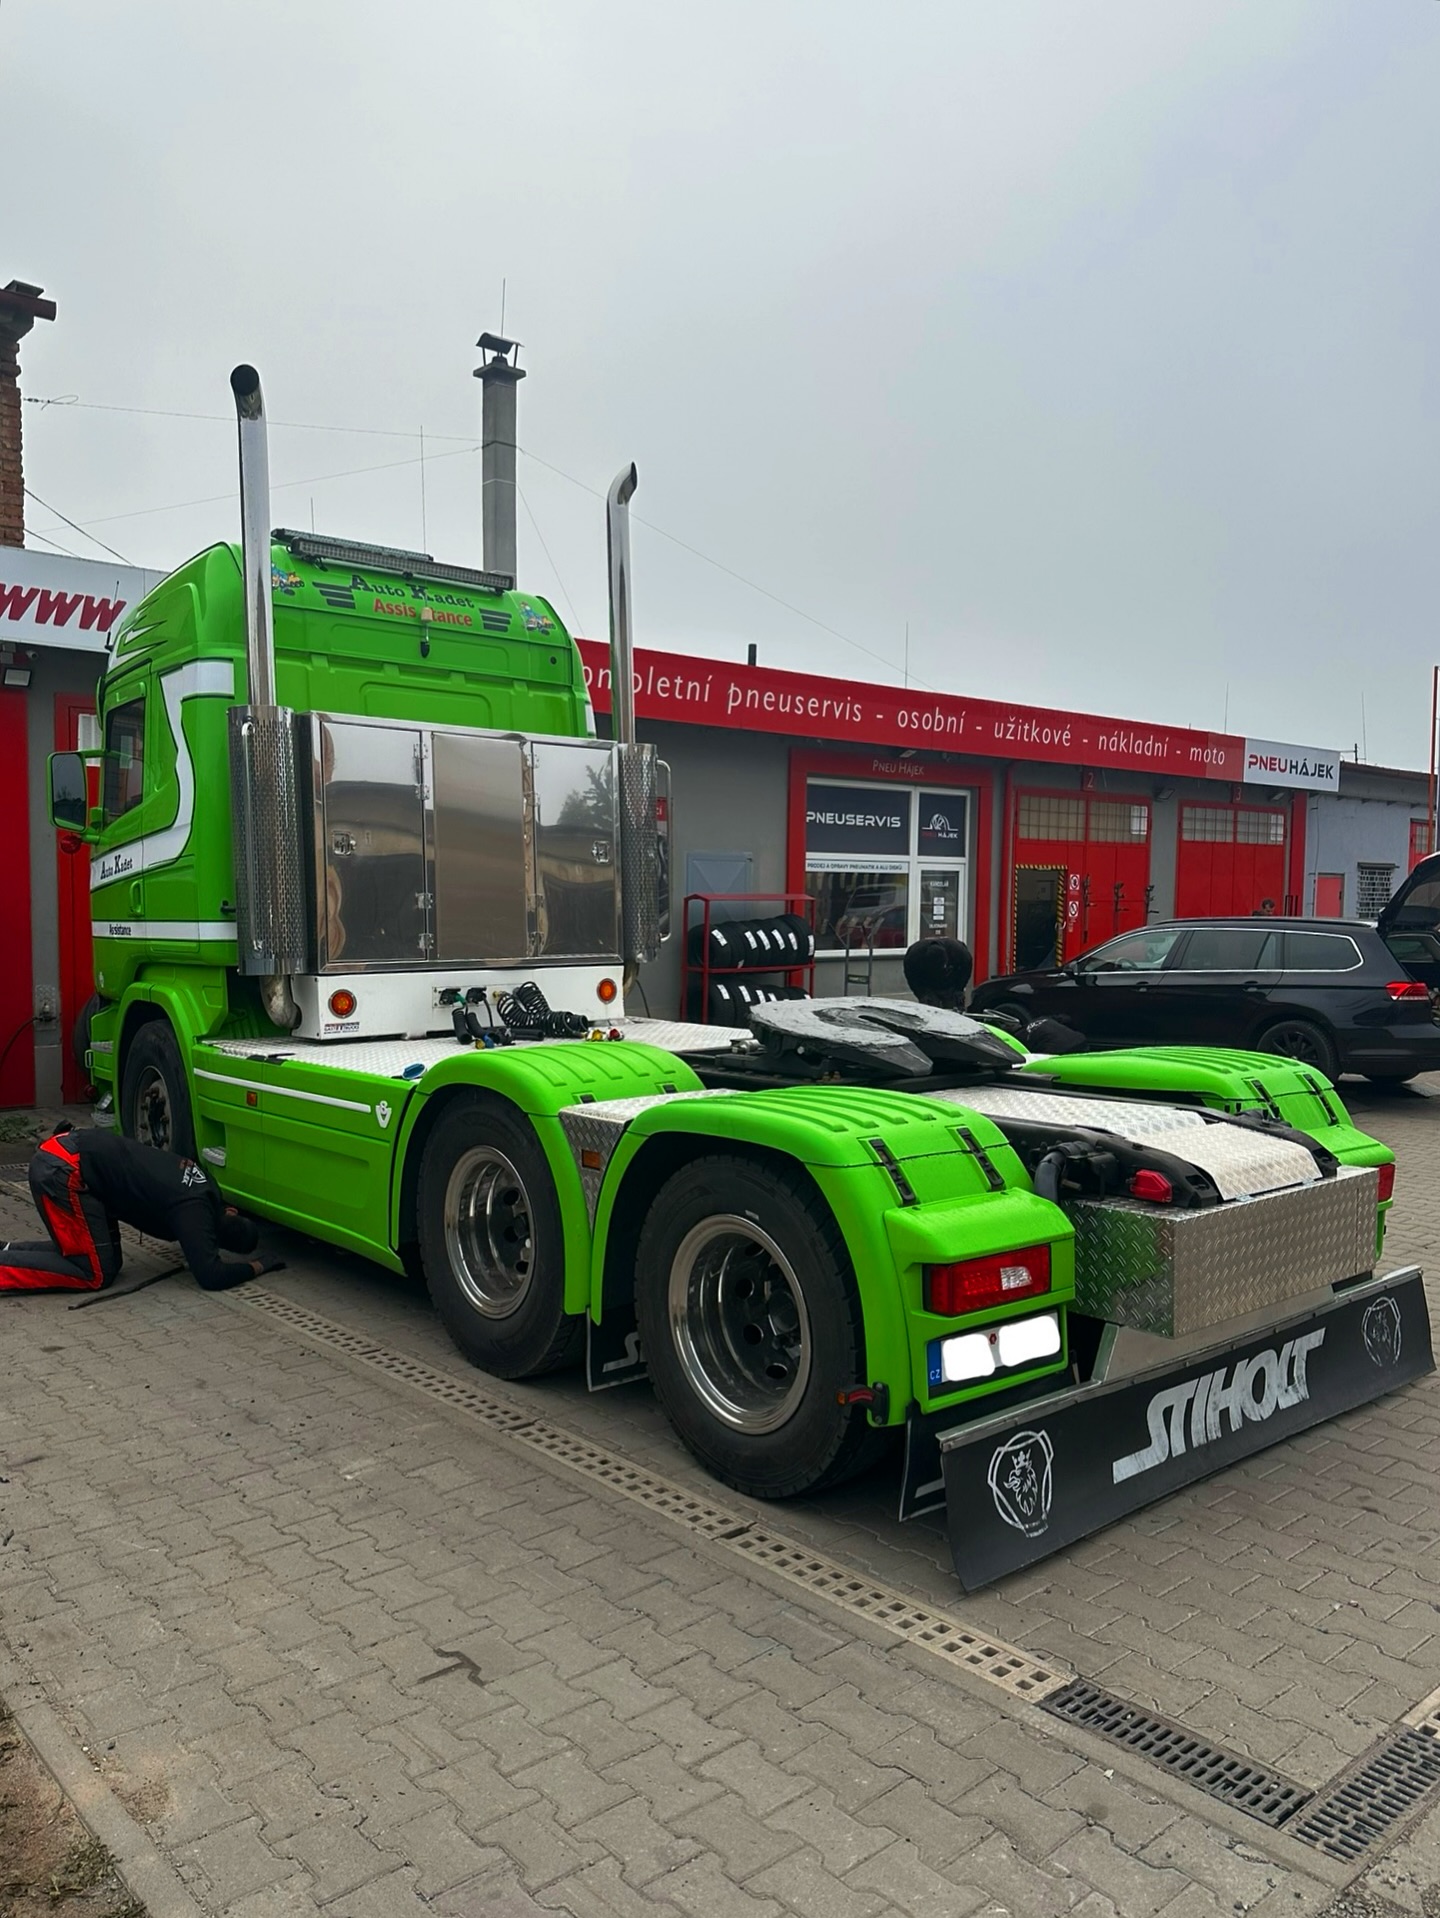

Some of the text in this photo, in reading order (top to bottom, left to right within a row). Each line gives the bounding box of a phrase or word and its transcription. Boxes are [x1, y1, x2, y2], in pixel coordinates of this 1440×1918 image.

[350, 574, 474, 608] Auto Kadet
[0, 583, 127, 632] www
[583, 665, 713, 702] onletní
[727, 682, 862, 722] pneuservis
[897, 707, 966, 734] osobní
[994, 716, 1071, 747] užitkové
[1098, 731, 1169, 758] nákladní
[1189, 747, 1225, 766] moto
[1087, 772, 1094, 788] 2
[1290, 758, 1334, 780] HÁJEK
[1235, 788, 1242, 801] 3
[806, 811, 901, 828] PNEUSERVIS
[930, 1369, 940, 1380] CZ
[1112, 1328, 1327, 1484] STIHOLT
